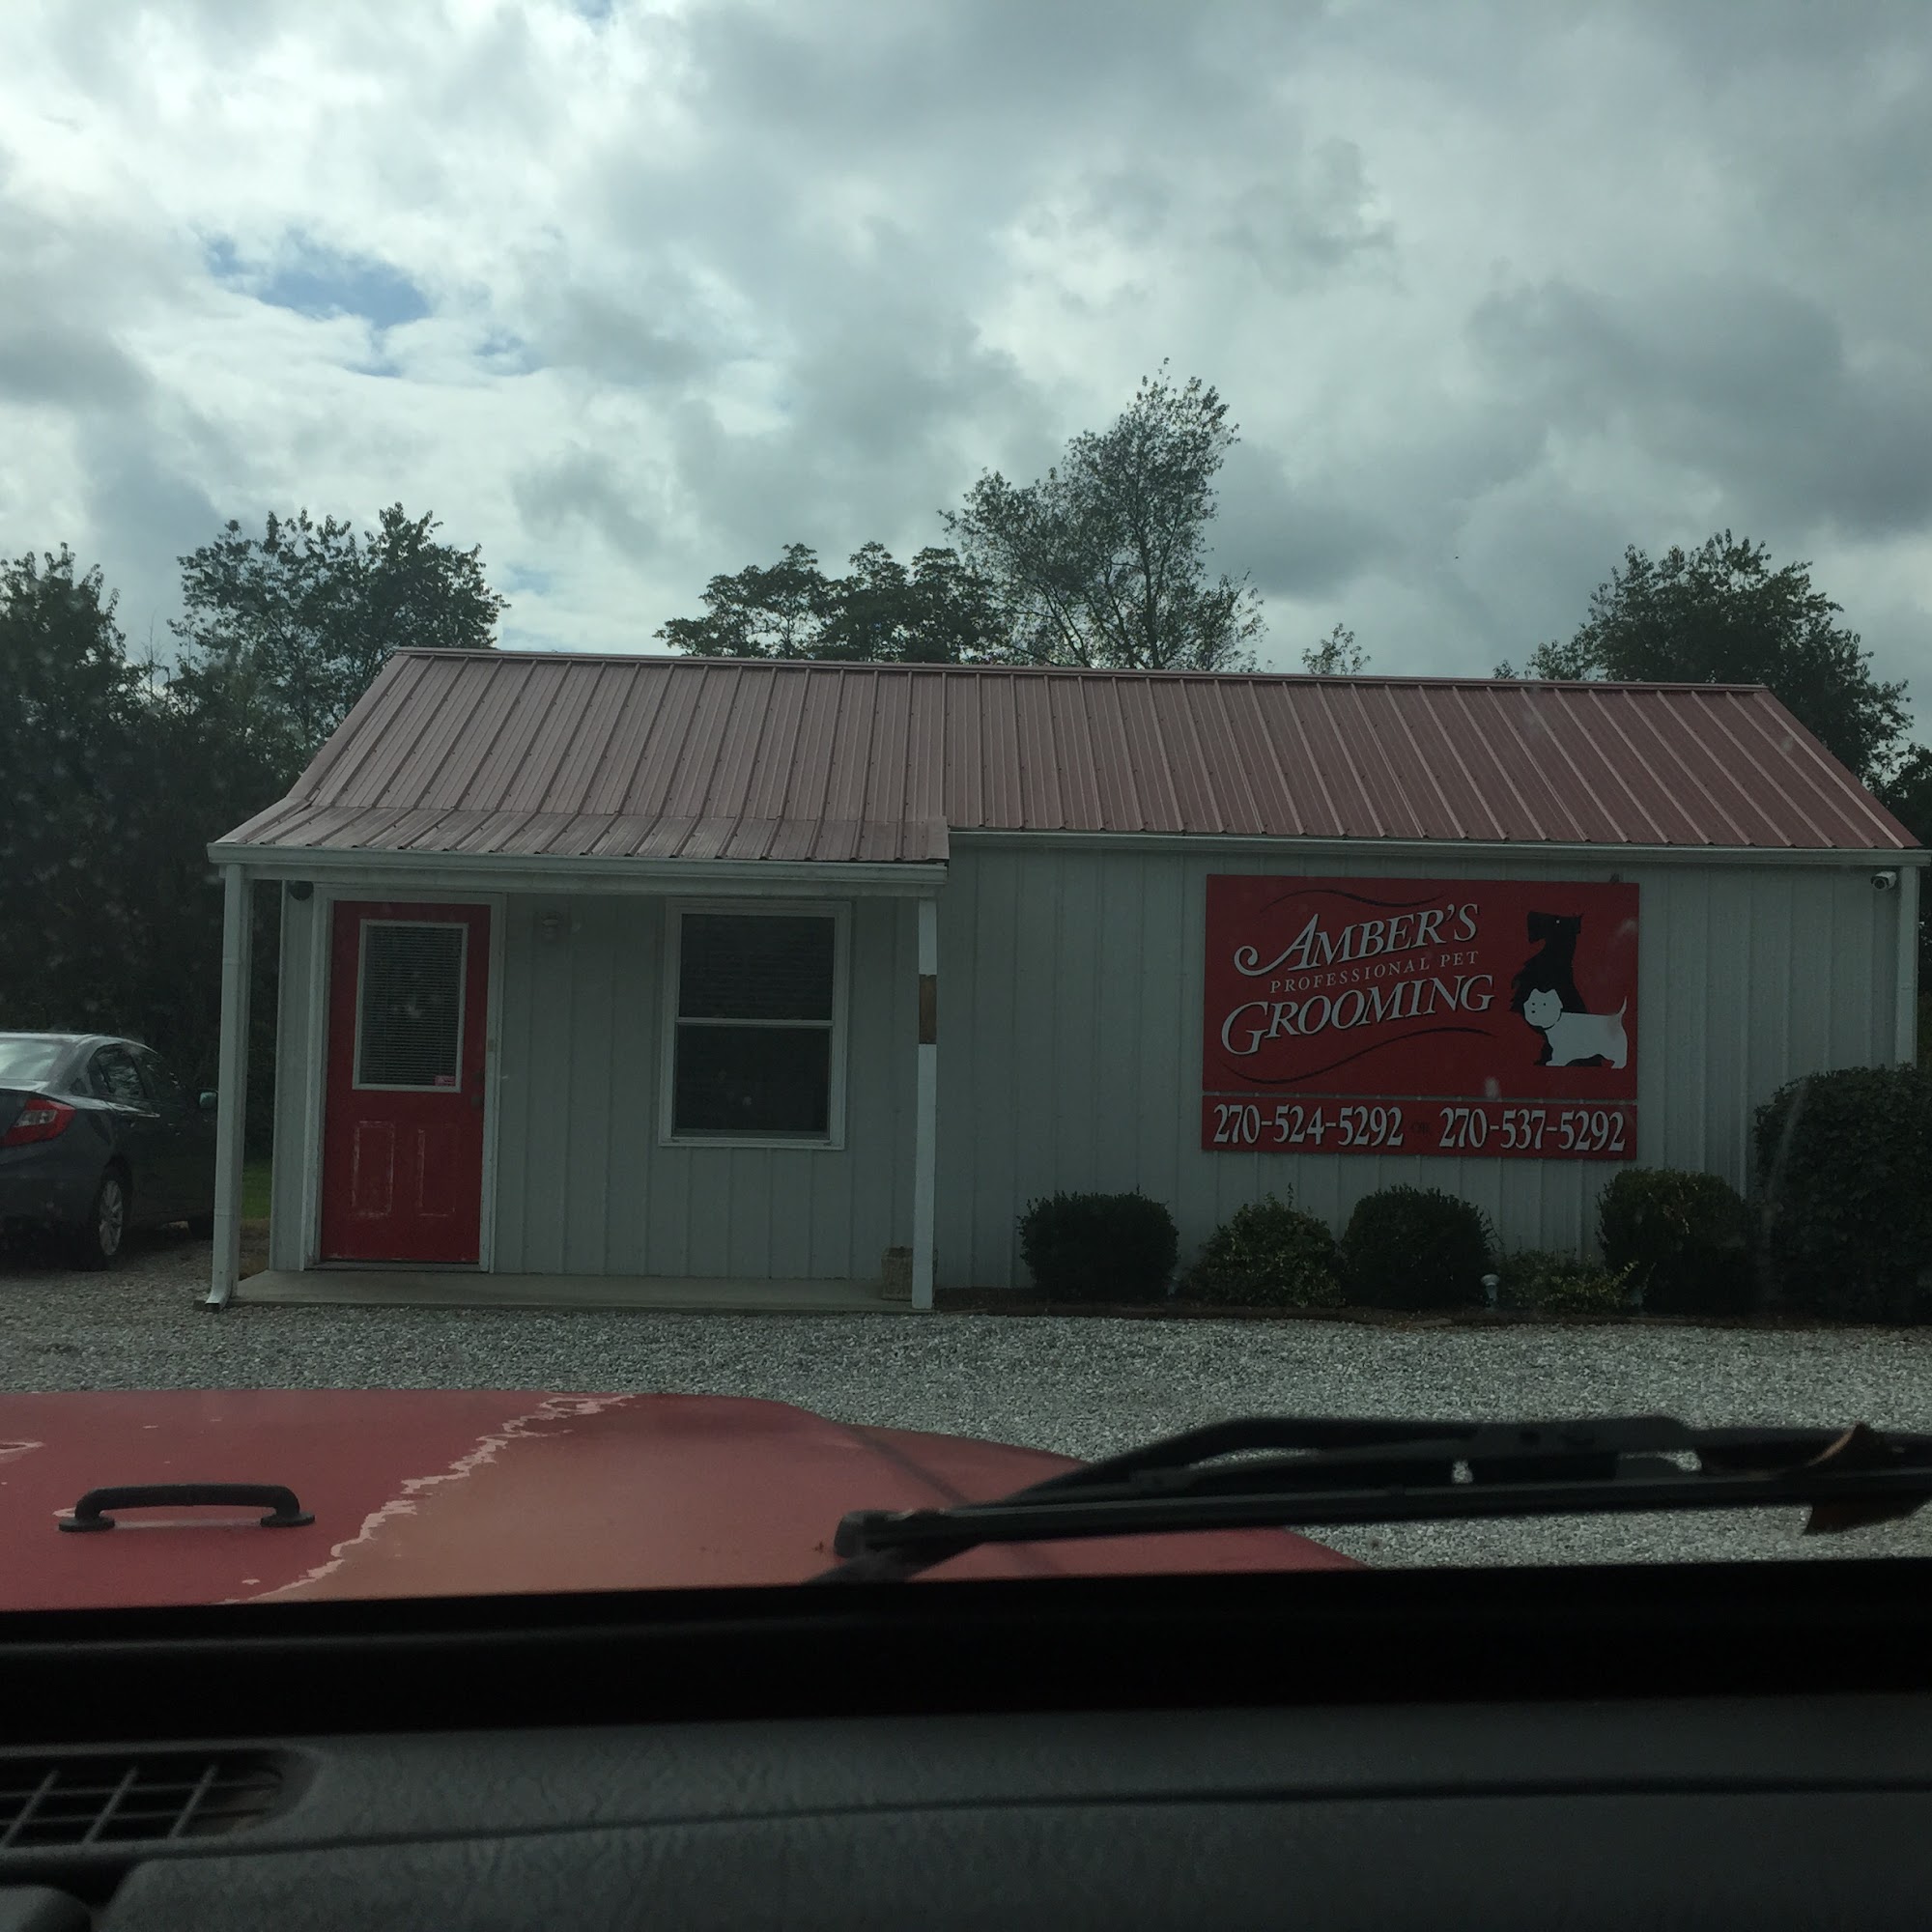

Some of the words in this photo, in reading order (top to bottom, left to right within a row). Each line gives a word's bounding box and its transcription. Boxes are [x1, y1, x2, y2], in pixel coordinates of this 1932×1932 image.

[1234, 903, 1480, 977] AMBER'S
[1269, 958, 1430, 994] PROFESSIONAL
[1439, 951, 1480, 970] PET
[1221, 974, 1494, 1056] GROOMING
[1213, 1104, 1404, 1146] 270-524-5292
[1439, 1107, 1627, 1151] 270-537-5292
